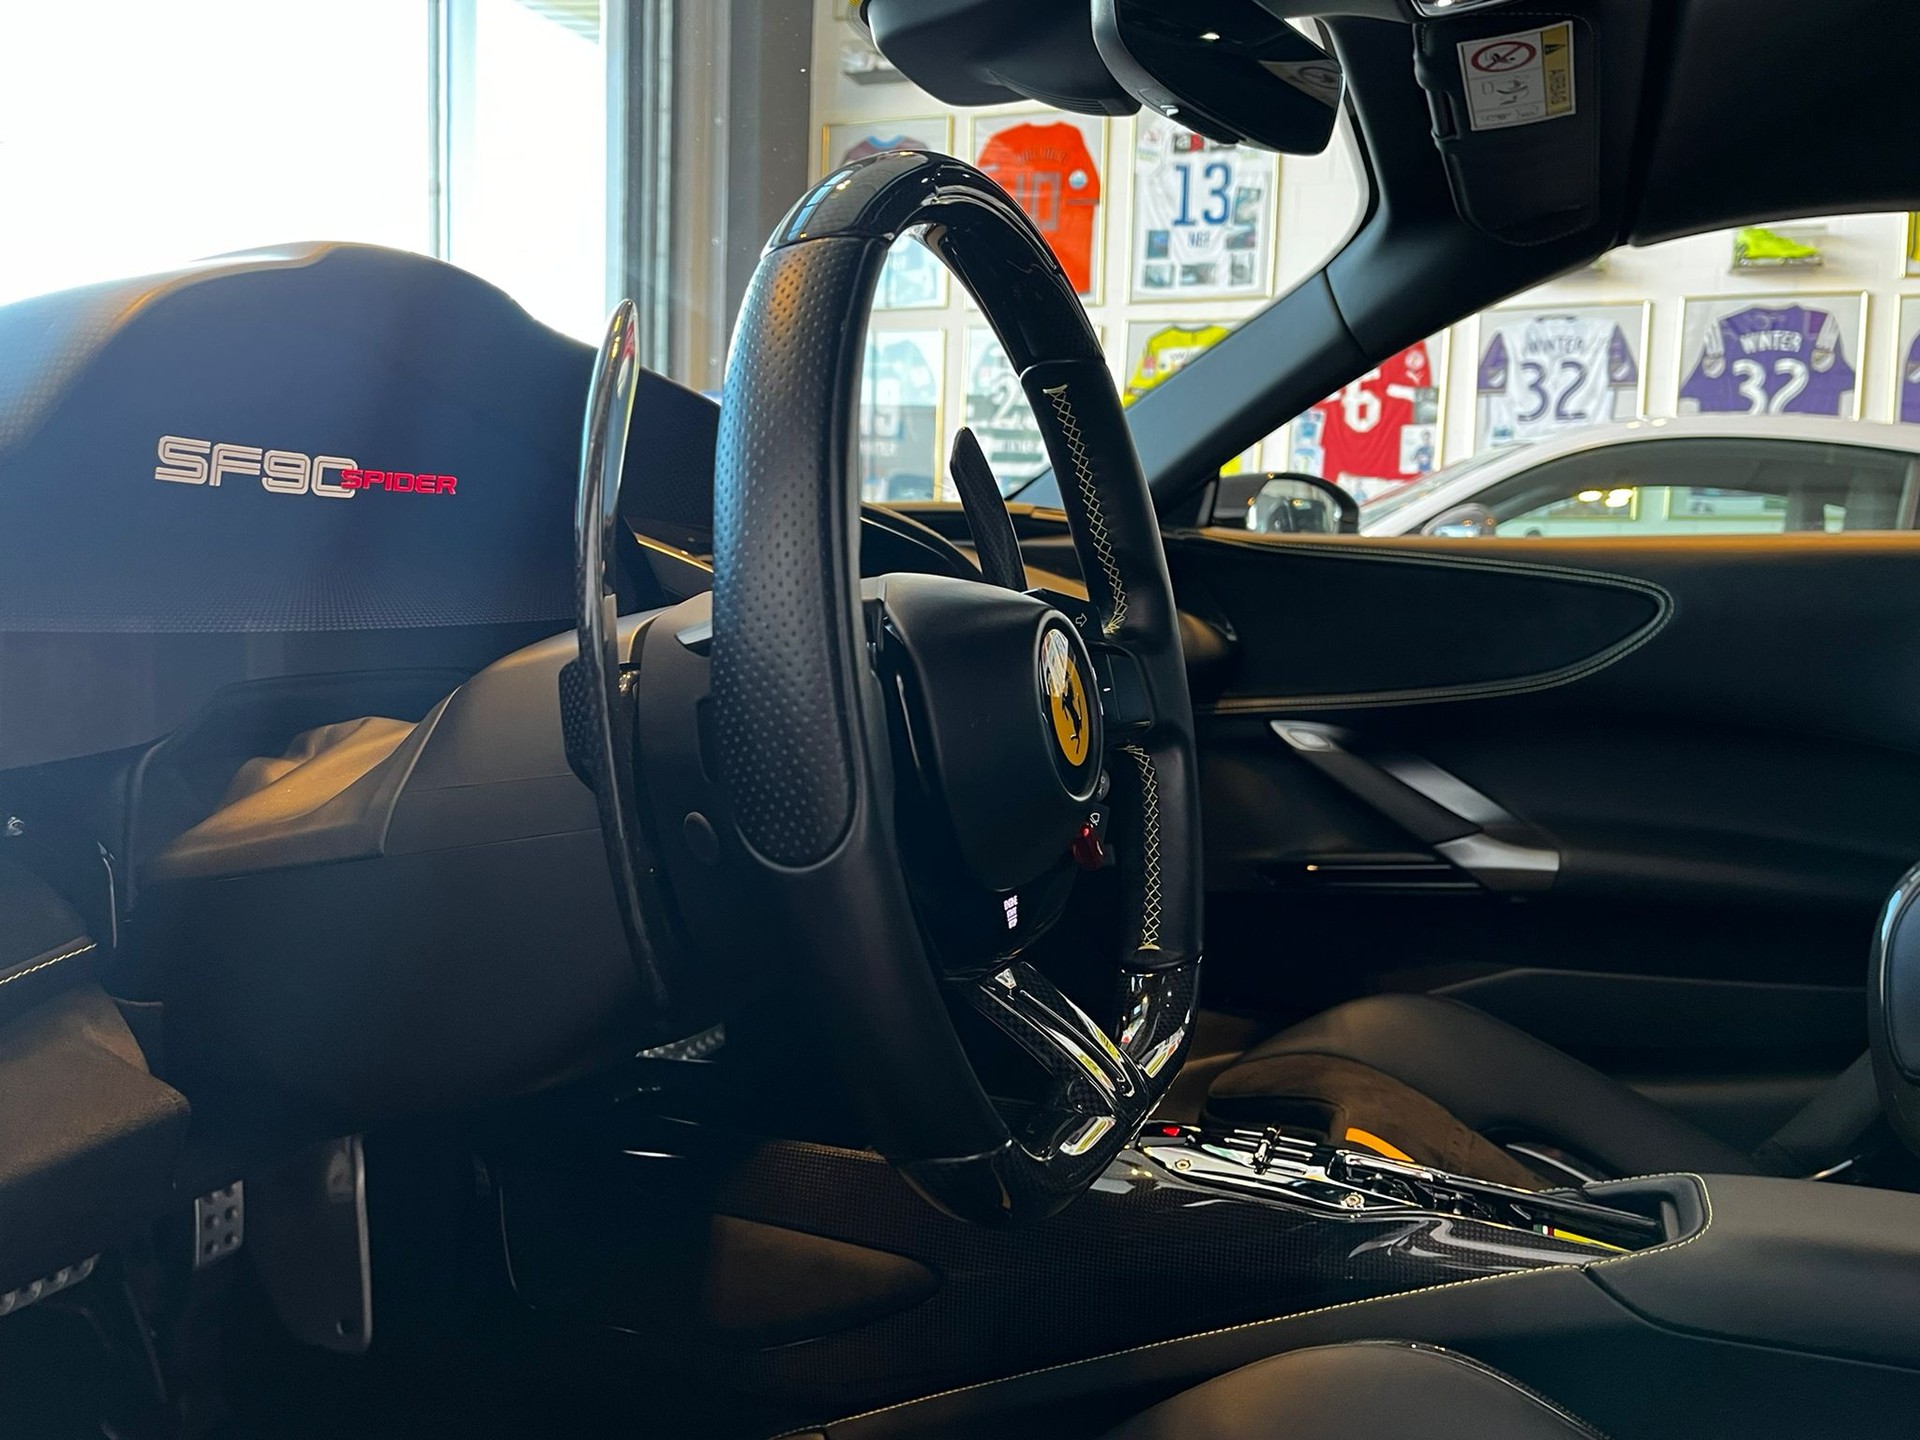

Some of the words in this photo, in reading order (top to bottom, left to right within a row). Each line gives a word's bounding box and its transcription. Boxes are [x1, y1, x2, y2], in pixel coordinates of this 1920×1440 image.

[1173, 162, 1231, 226] 13
[1740, 330, 1802, 354] WINTER
[1517, 360, 1587, 422] 32
[1732, 357, 1809, 415] 32
[155, 434, 358, 499] SF90
[341, 469, 458, 495] SPIDER
